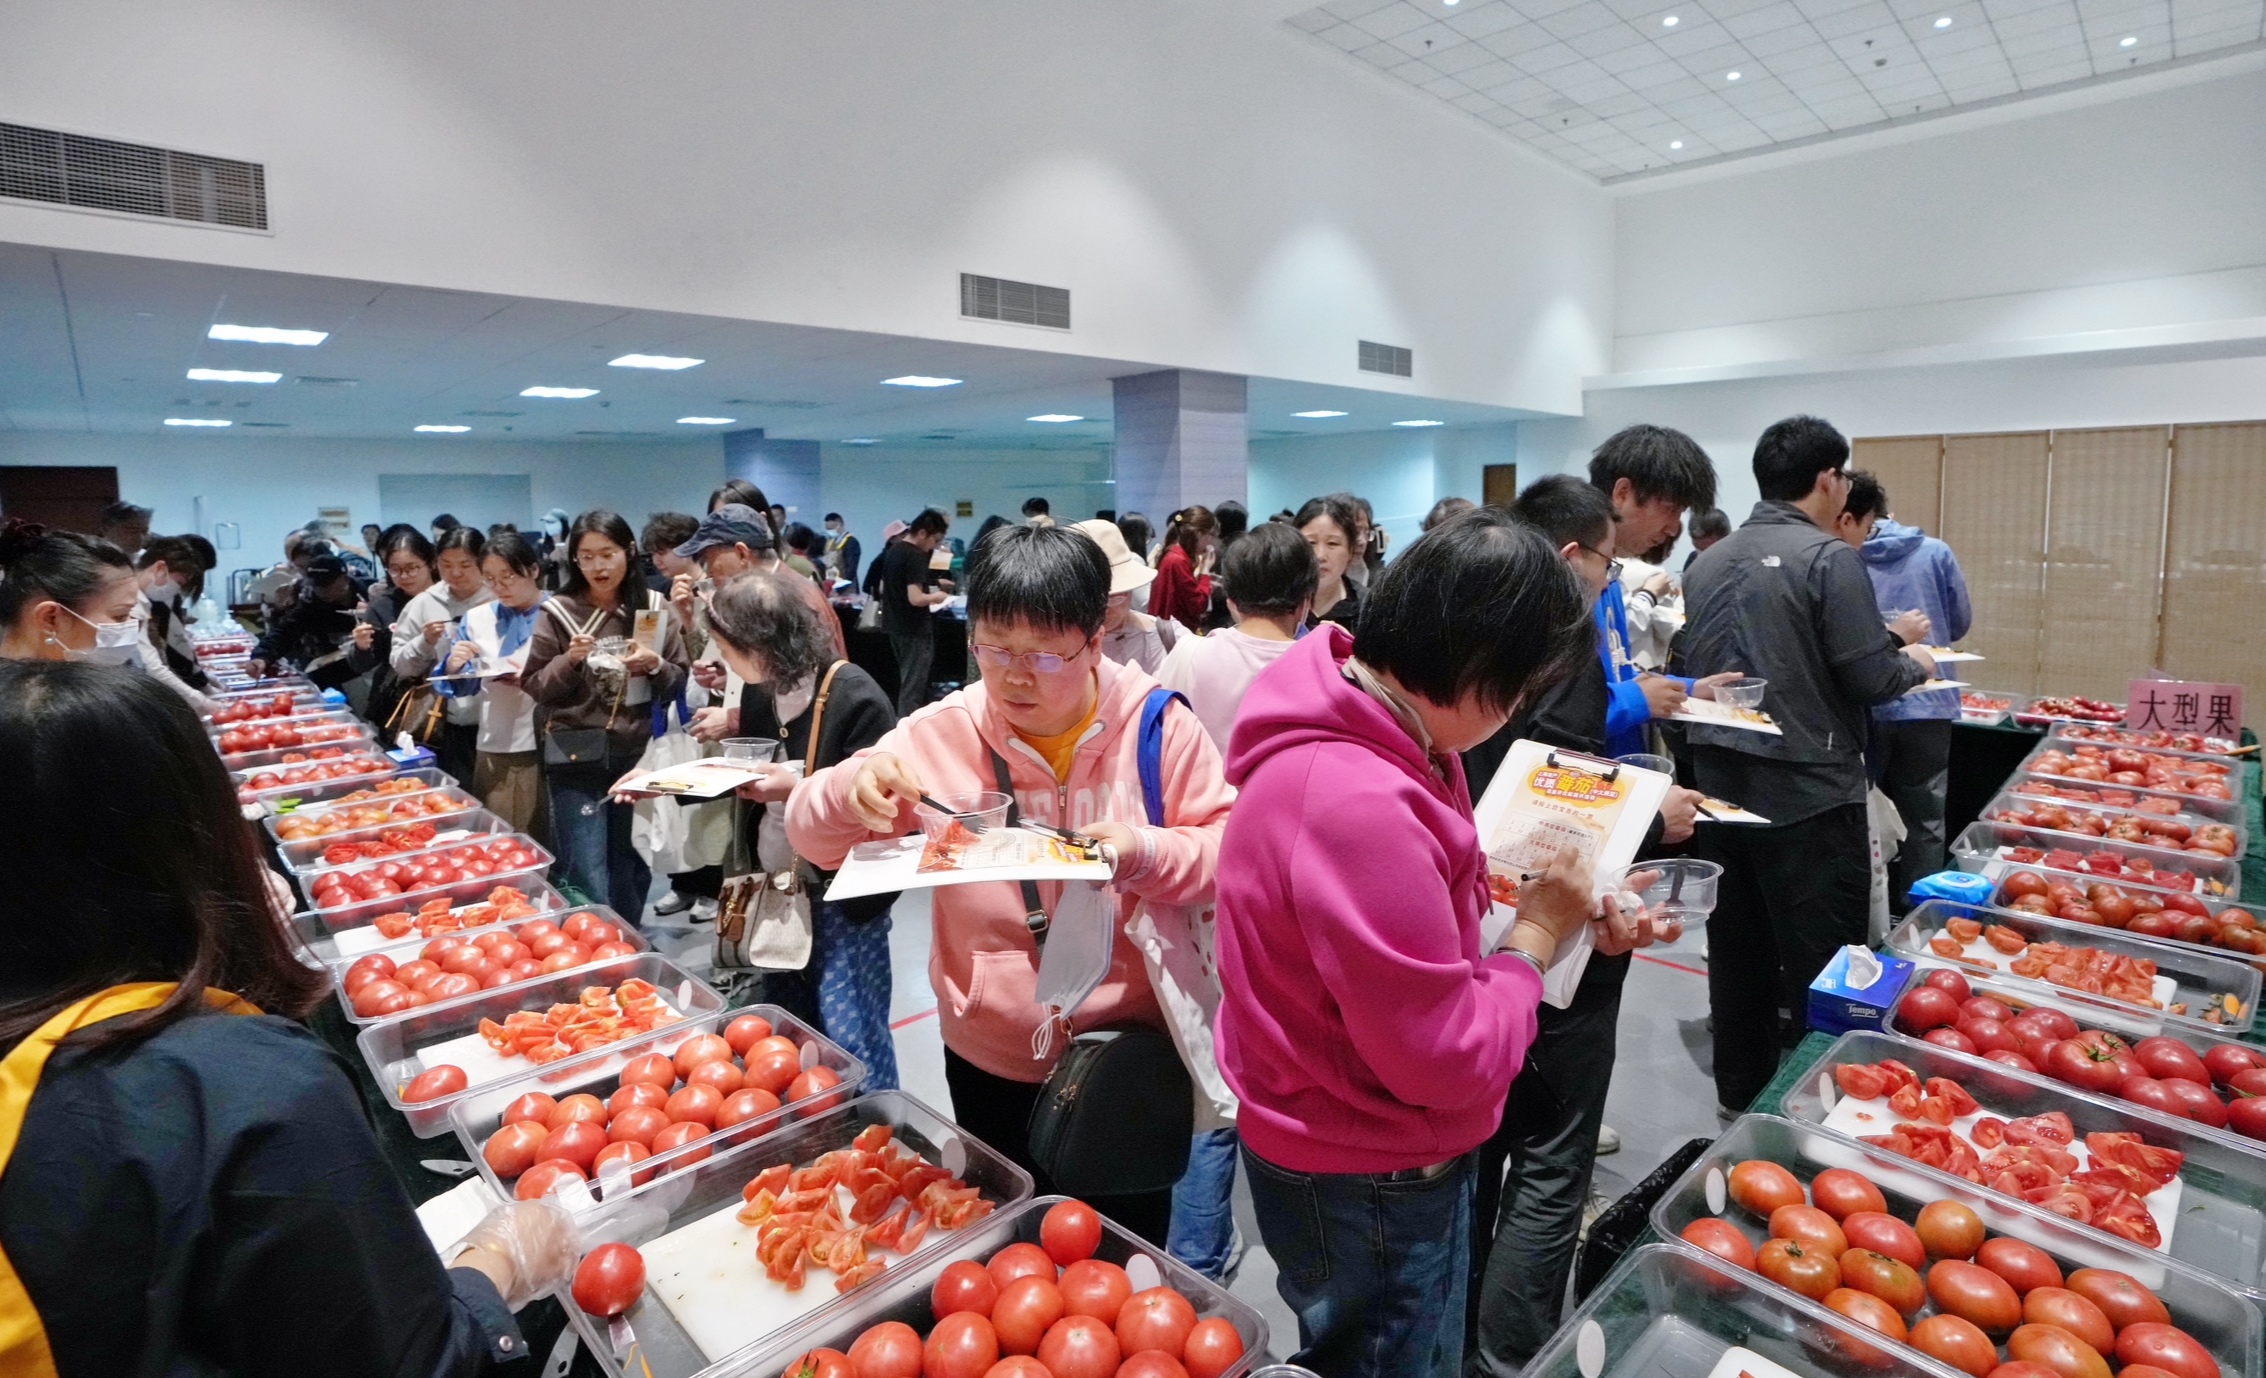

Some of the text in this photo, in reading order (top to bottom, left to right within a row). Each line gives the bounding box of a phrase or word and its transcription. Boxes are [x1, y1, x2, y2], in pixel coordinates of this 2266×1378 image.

[2137, 689, 2234, 736] 大型果
[1846, 1003, 1878, 1017] Tempo
